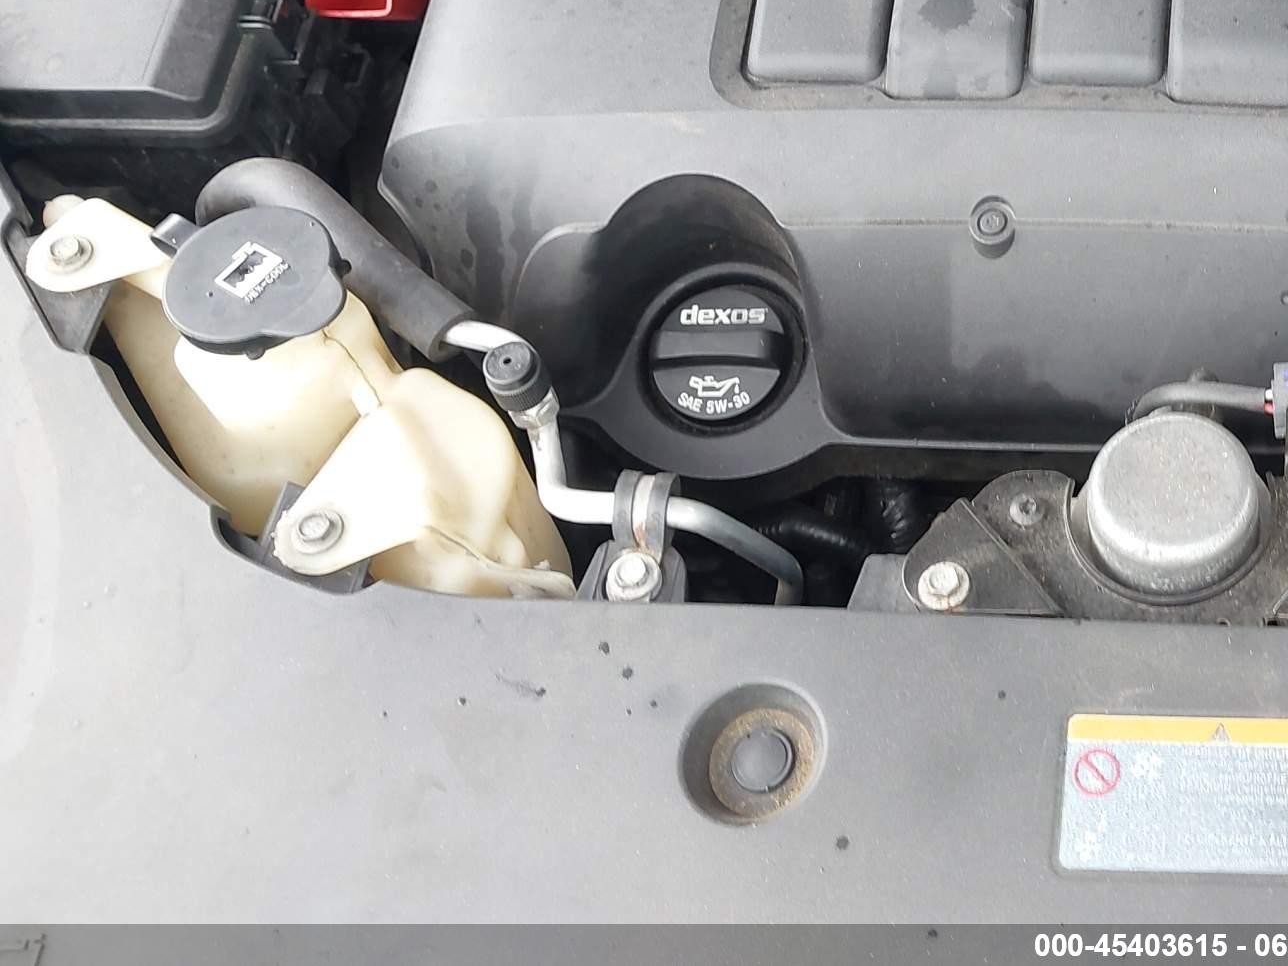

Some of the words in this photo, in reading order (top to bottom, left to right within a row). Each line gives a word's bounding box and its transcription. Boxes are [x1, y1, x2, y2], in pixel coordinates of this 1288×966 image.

[680, 304, 766, 325] dexos
[677, 392, 703, 413] SAE
[705, 391, 750, 414] 5W-30
